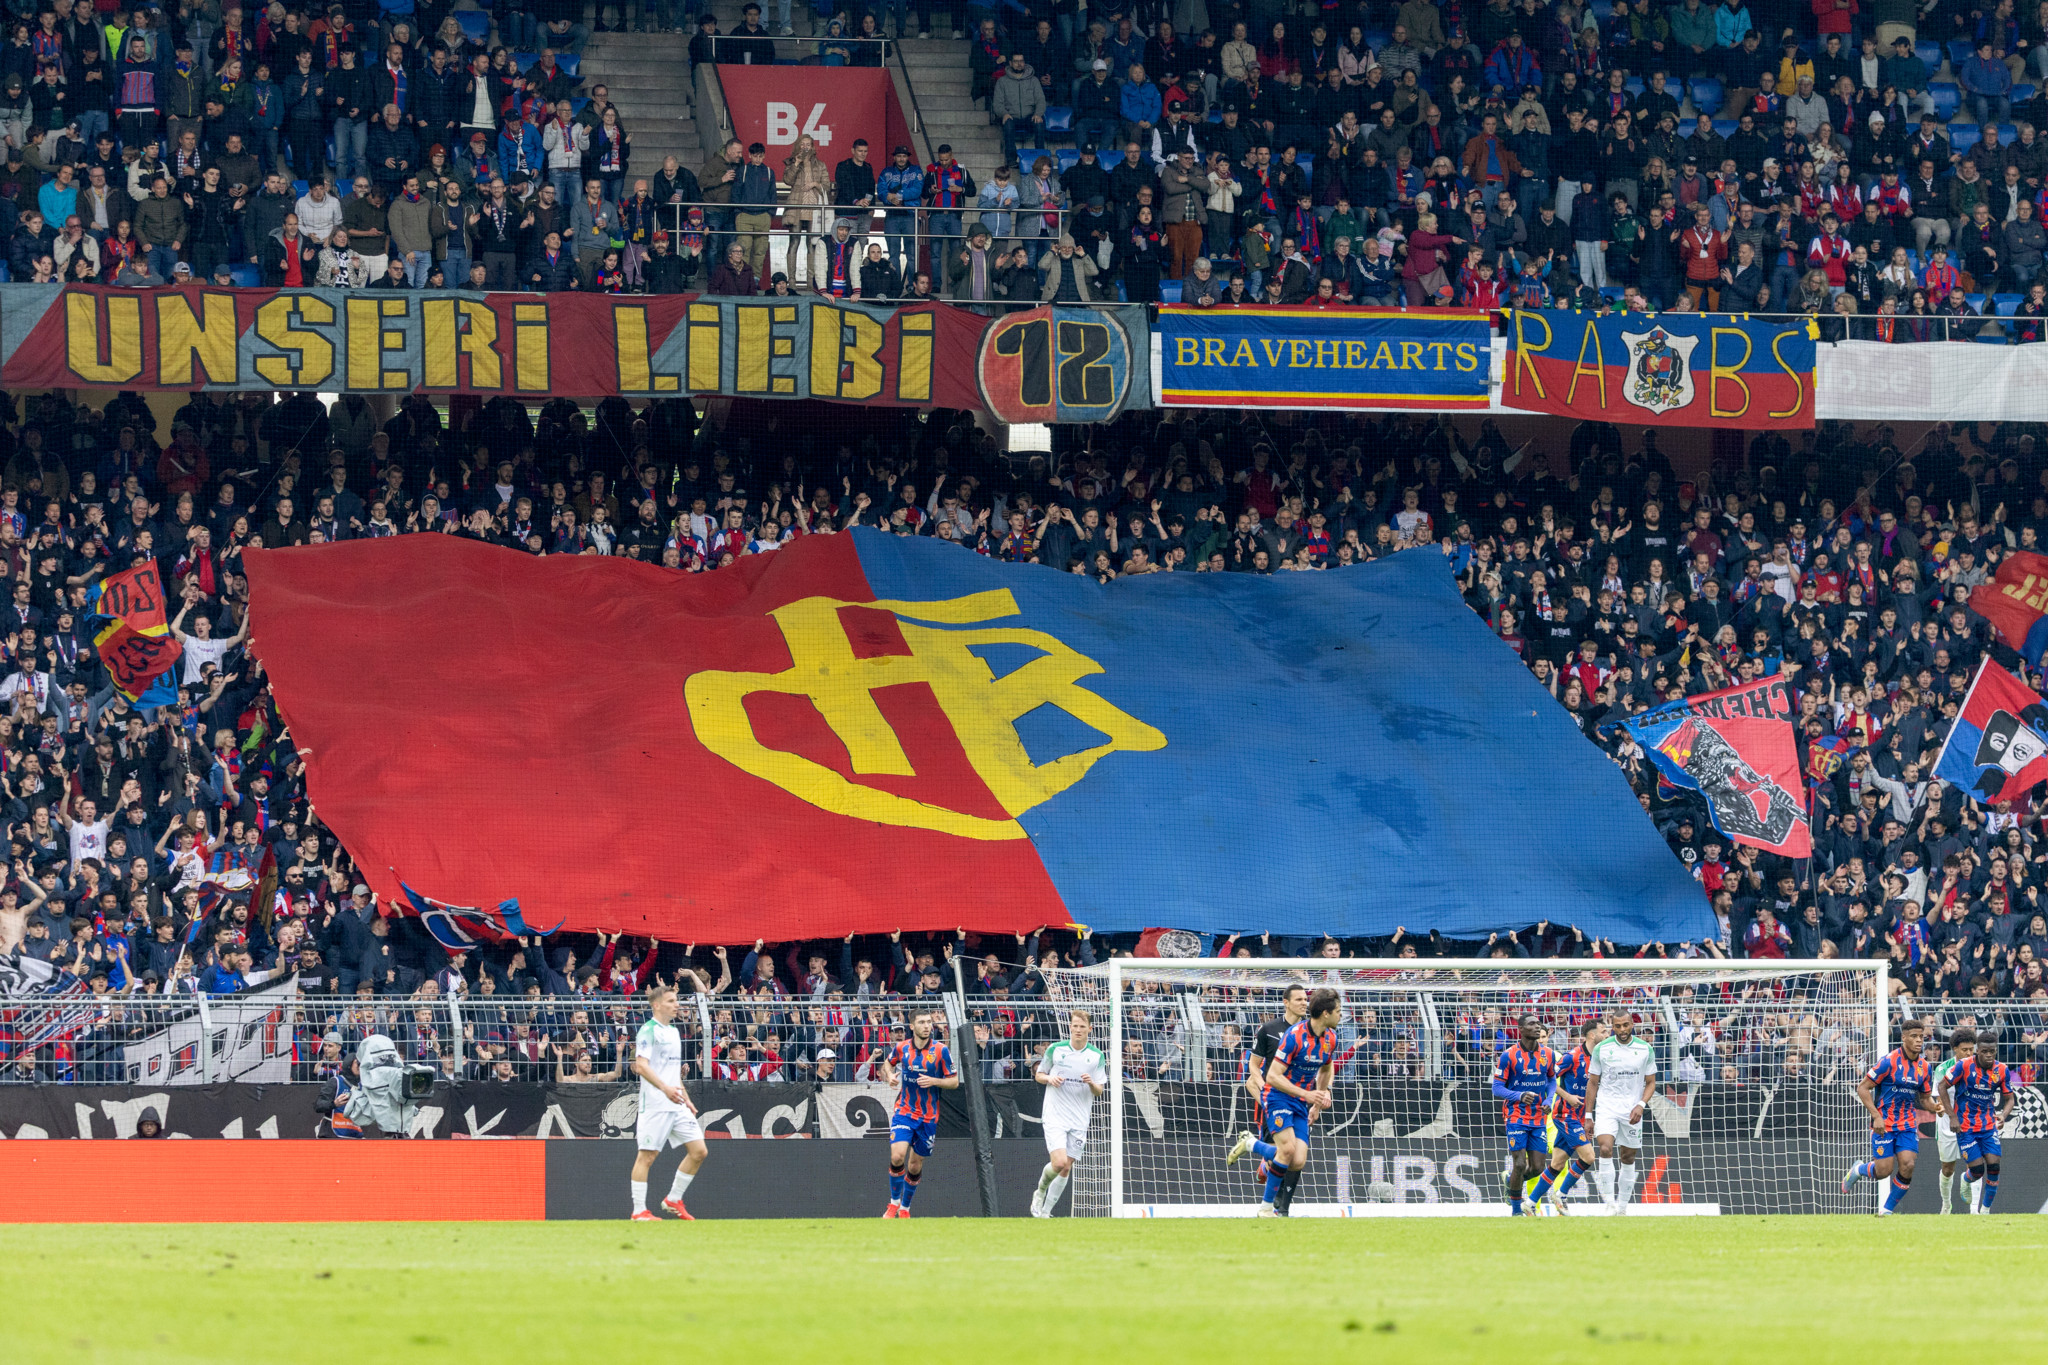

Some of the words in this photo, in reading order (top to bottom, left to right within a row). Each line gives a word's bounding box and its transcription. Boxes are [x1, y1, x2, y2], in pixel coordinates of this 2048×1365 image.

[767, 102, 832, 146] B4
[995, 318, 1116, 408] 12
[1174, 337, 1479, 373] BRAVEHEARTS
